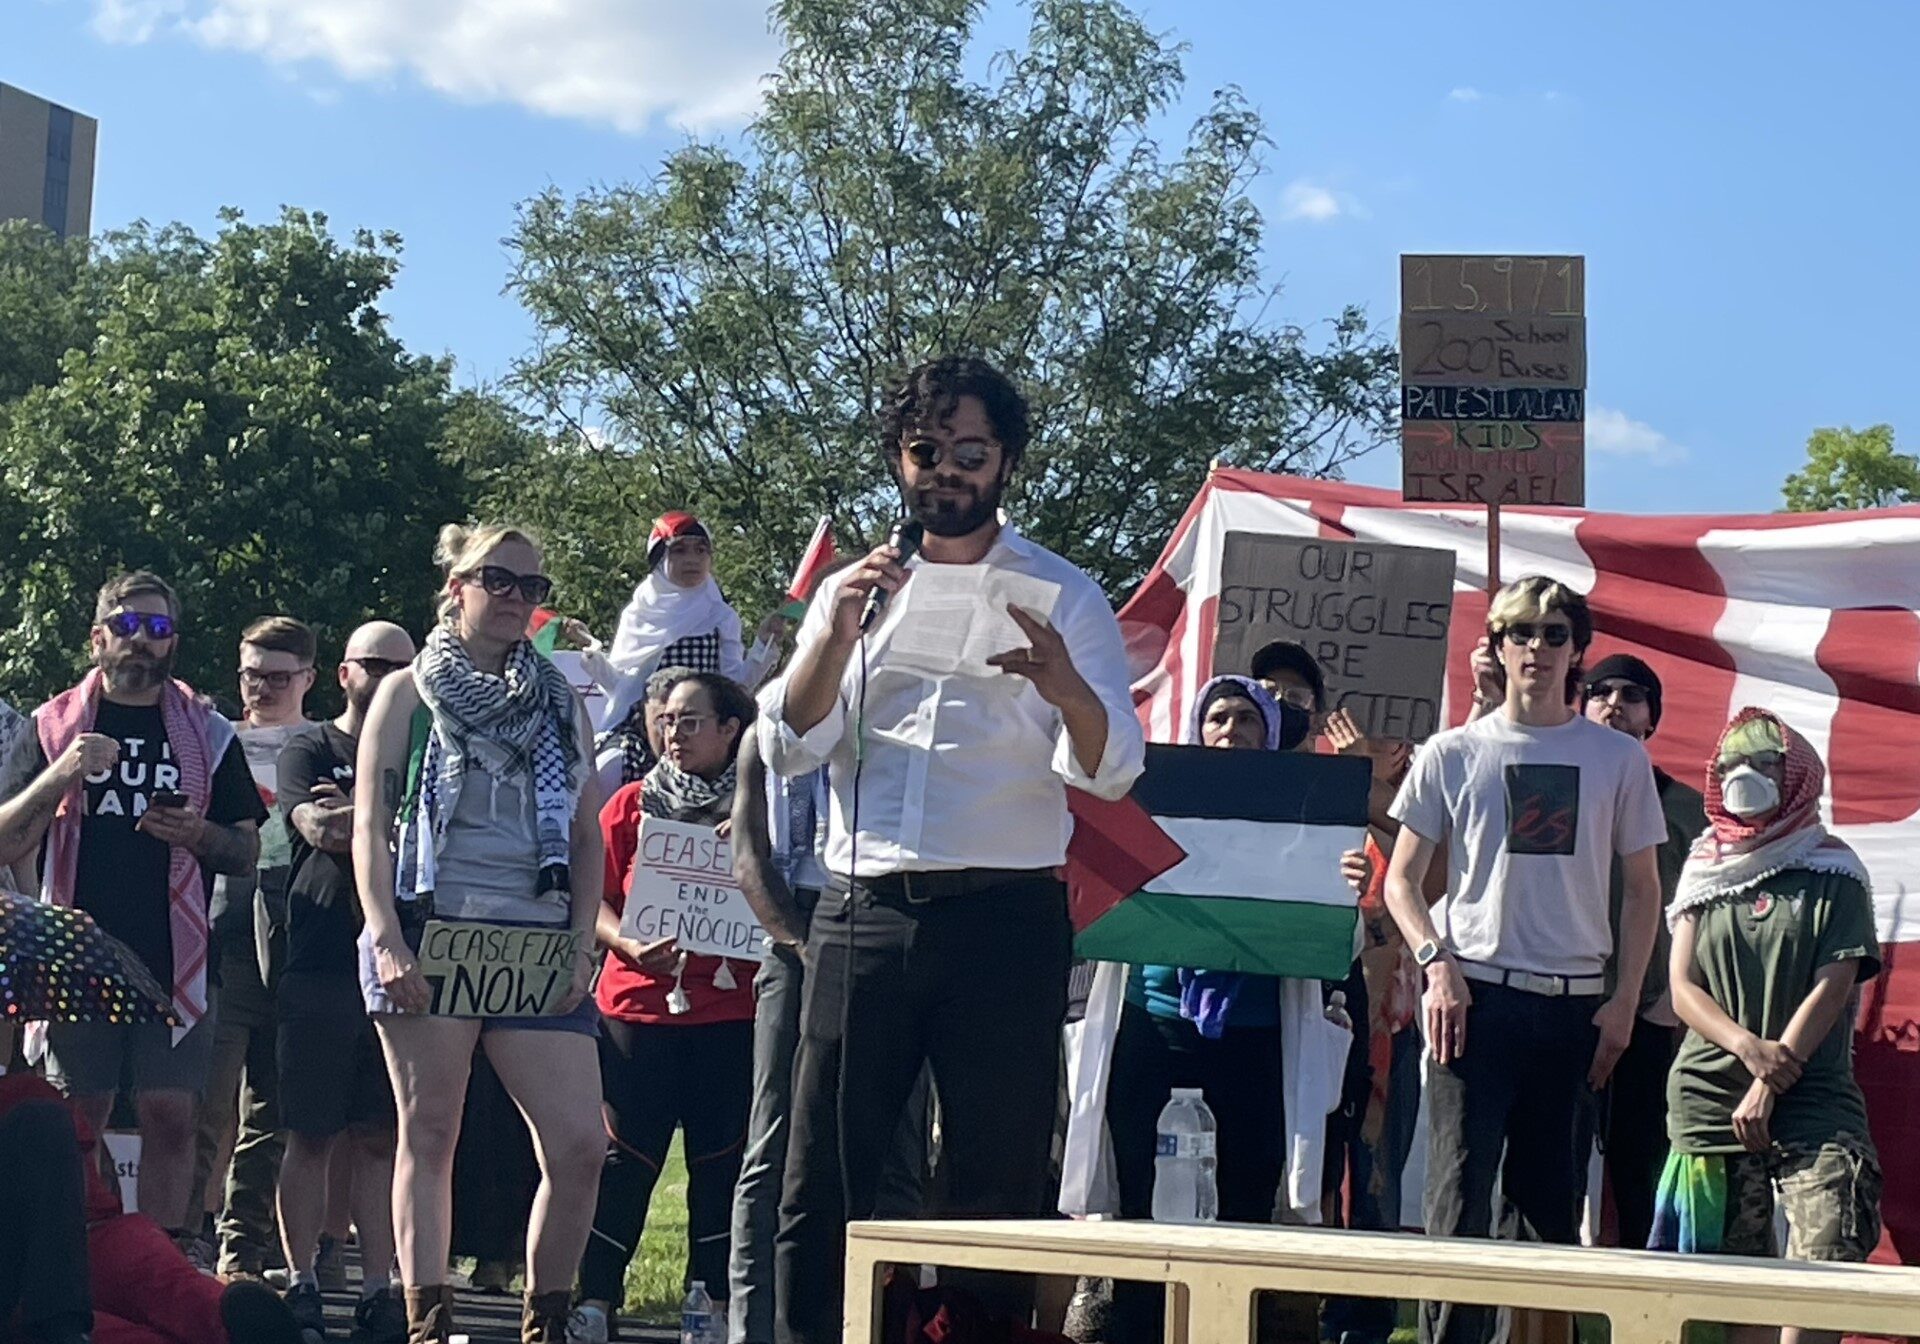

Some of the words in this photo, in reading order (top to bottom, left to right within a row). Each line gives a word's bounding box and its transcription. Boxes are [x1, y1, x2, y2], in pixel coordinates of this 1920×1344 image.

[1408, 257, 1582, 317] 15,971
[1412, 320, 1495, 376] 200
[1495, 319, 1570, 345] School
[1499, 349, 1570, 381] Buses
[1404, 385, 1584, 420] PALESTINIAN
[1455, 420, 1542, 451] KIDS
[1407, 473, 1566, 504] ISRAEL
[1300, 544, 1374, 584] OUR
[1221, 585, 1451, 641] STRUGGLES
[1302, 640, 1369, 679] RE
[1327, 687, 1437, 743] CTED
[677, 882, 729, 905] END
[687, 903, 709, 915] the
[428, 927, 585, 971] CEASEFIRE
[635, 904, 763, 955] GENOCIDE
[448, 963, 558, 1015] NOW
